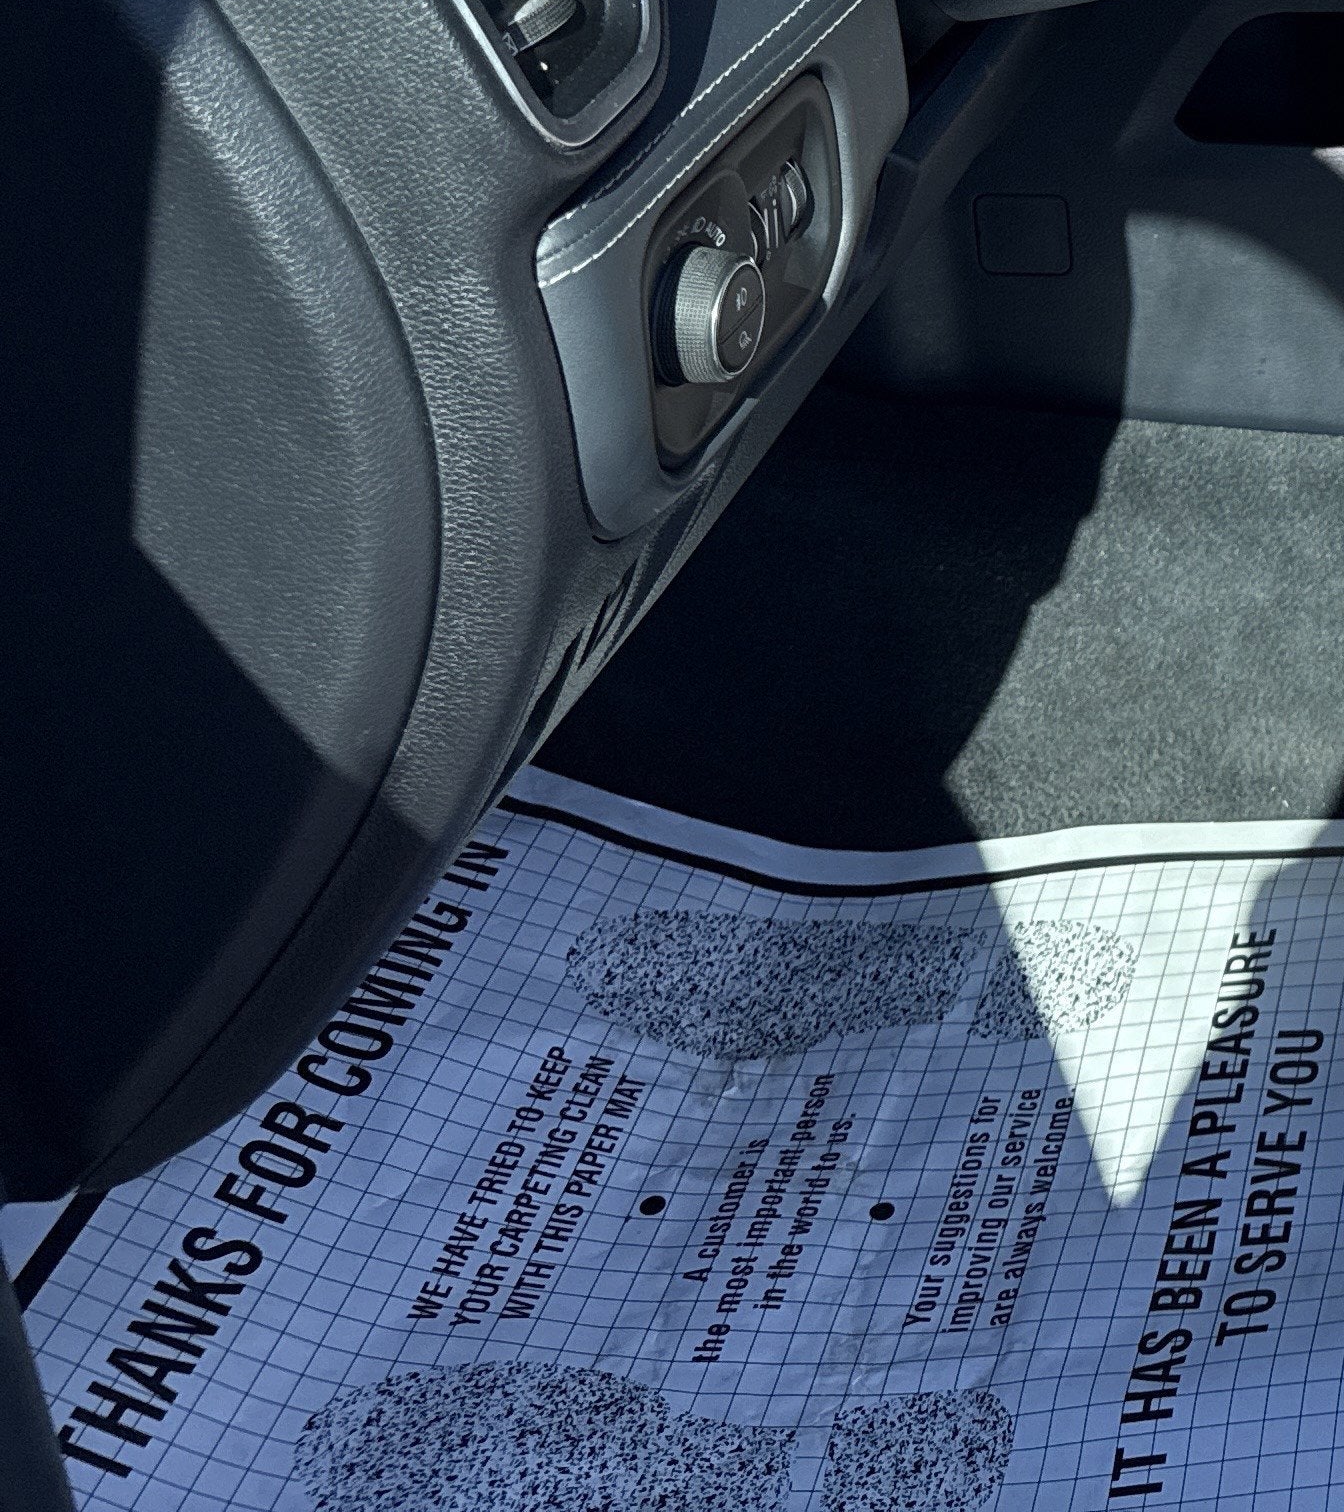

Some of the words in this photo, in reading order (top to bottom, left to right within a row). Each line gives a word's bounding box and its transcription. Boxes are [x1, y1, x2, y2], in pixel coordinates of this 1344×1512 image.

[705, 221, 726, 247] AUTO
[1188, 928, 1277, 1137] PLEASURE
[791, 1074, 835, 1142] person
[1263, 1029, 1324, 1116] YOU
[57, 1226, 263, 1478] THANKS
[213, 1101, 346, 1224] FOR
[297, 896, 472, 1096] COMING
[444, 841, 509, 890] IN
[812, 1151, 841, 1172] to
[827, 1113, 857, 1144] us.
[1001, 1088, 1041, 1167] service
[1030, 1088, 1076, 1195] welcome.
[1180, 1149, 1231, 1179] A
[406, 1281, 452, 1319] WE
[432, 1212, 488, 1276] HAVE
[468, 1141, 525, 1205] TRIED
[507, 1106, 545, 1132] TO
[526, 1046, 572, 1101] KEEP
[450, 1262, 509, 1327] YOUR
[490, 1127, 577, 1257] CARPETING
[560, 1055, 615, 1122] CLEAN
[500, 1262, 555, 1319] WITH
[534, 1203, 584, 1253] THIS
[565, 1123, 623, 1197] PAPER
[604, 1075, 646, 1119] MAT
[683, 1266, 711, 1281] A
[697, 1162, 754, 1259] customer
[740, 1138, 769, 1156] is
[736, 1148, 804, 1247] important
[788, 1177, 830, 1236] world
[902, 1275, 944, 1329] Your
[930, 1131, 990, 1266] suggestions
[970, 1096, 1001, 1124] for
[988, 1174, 1016, 1209] our
[1234, 1131, 1307, 1275] SERVE
[766, 1243, 803, 1279] the
[940, 1217, 1008, 1333] improving
[1003, 1201, 1046, 1280] always
[1149, 1197, 1222, 1312] BEEN
[717, 1255, 758, 1313] most
[753, 1288, 786, 1310] in
[990, 1287, 1018, 1327] are
[1215, 1289, 1277, 1347] TO
[692, 1323, 731, 1363] the
[1120, 1328, 1193, 1423] HAS
[1108, 1447, 1167, 1498] IT
